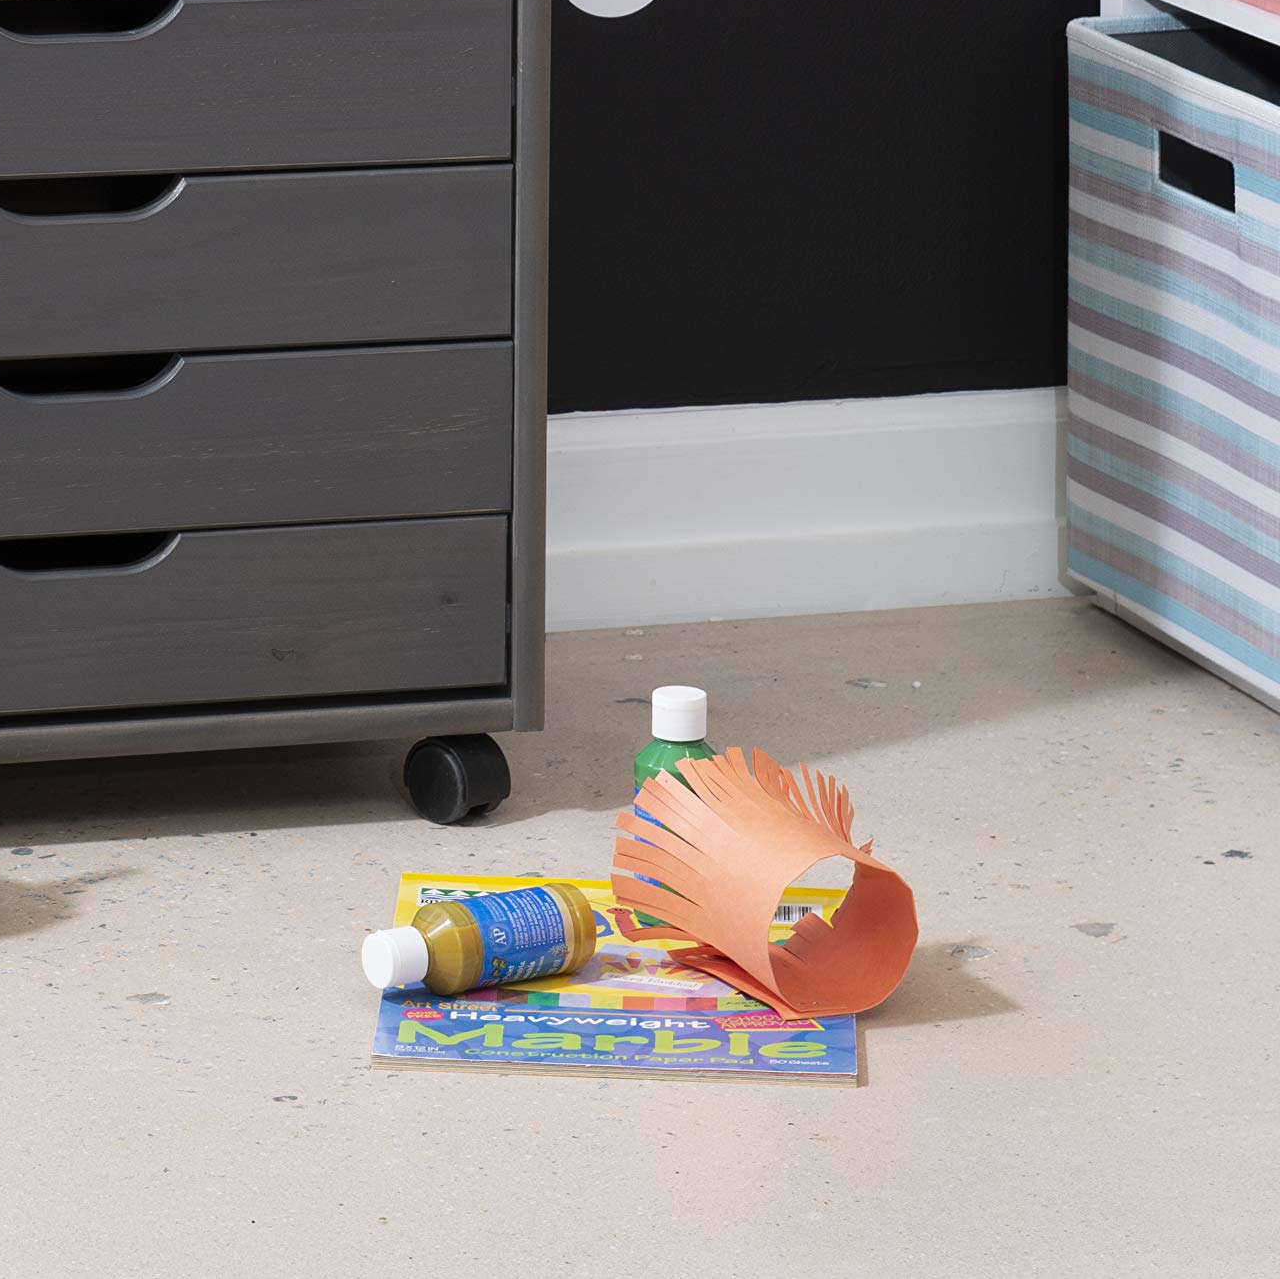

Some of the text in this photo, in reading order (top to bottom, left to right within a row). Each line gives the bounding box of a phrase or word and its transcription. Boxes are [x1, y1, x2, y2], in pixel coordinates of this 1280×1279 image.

[493, 928, 507, 945] AP
[400, 1000, 498, 1012] Art Street
[450, 1011, 711, 1029] Heavyweight
[721, 1019, 810, 1029] APPROVED
[397, 1020, 827, 1059] Marble
[464, 1048, 754, 1065] Construction Paper Pad
